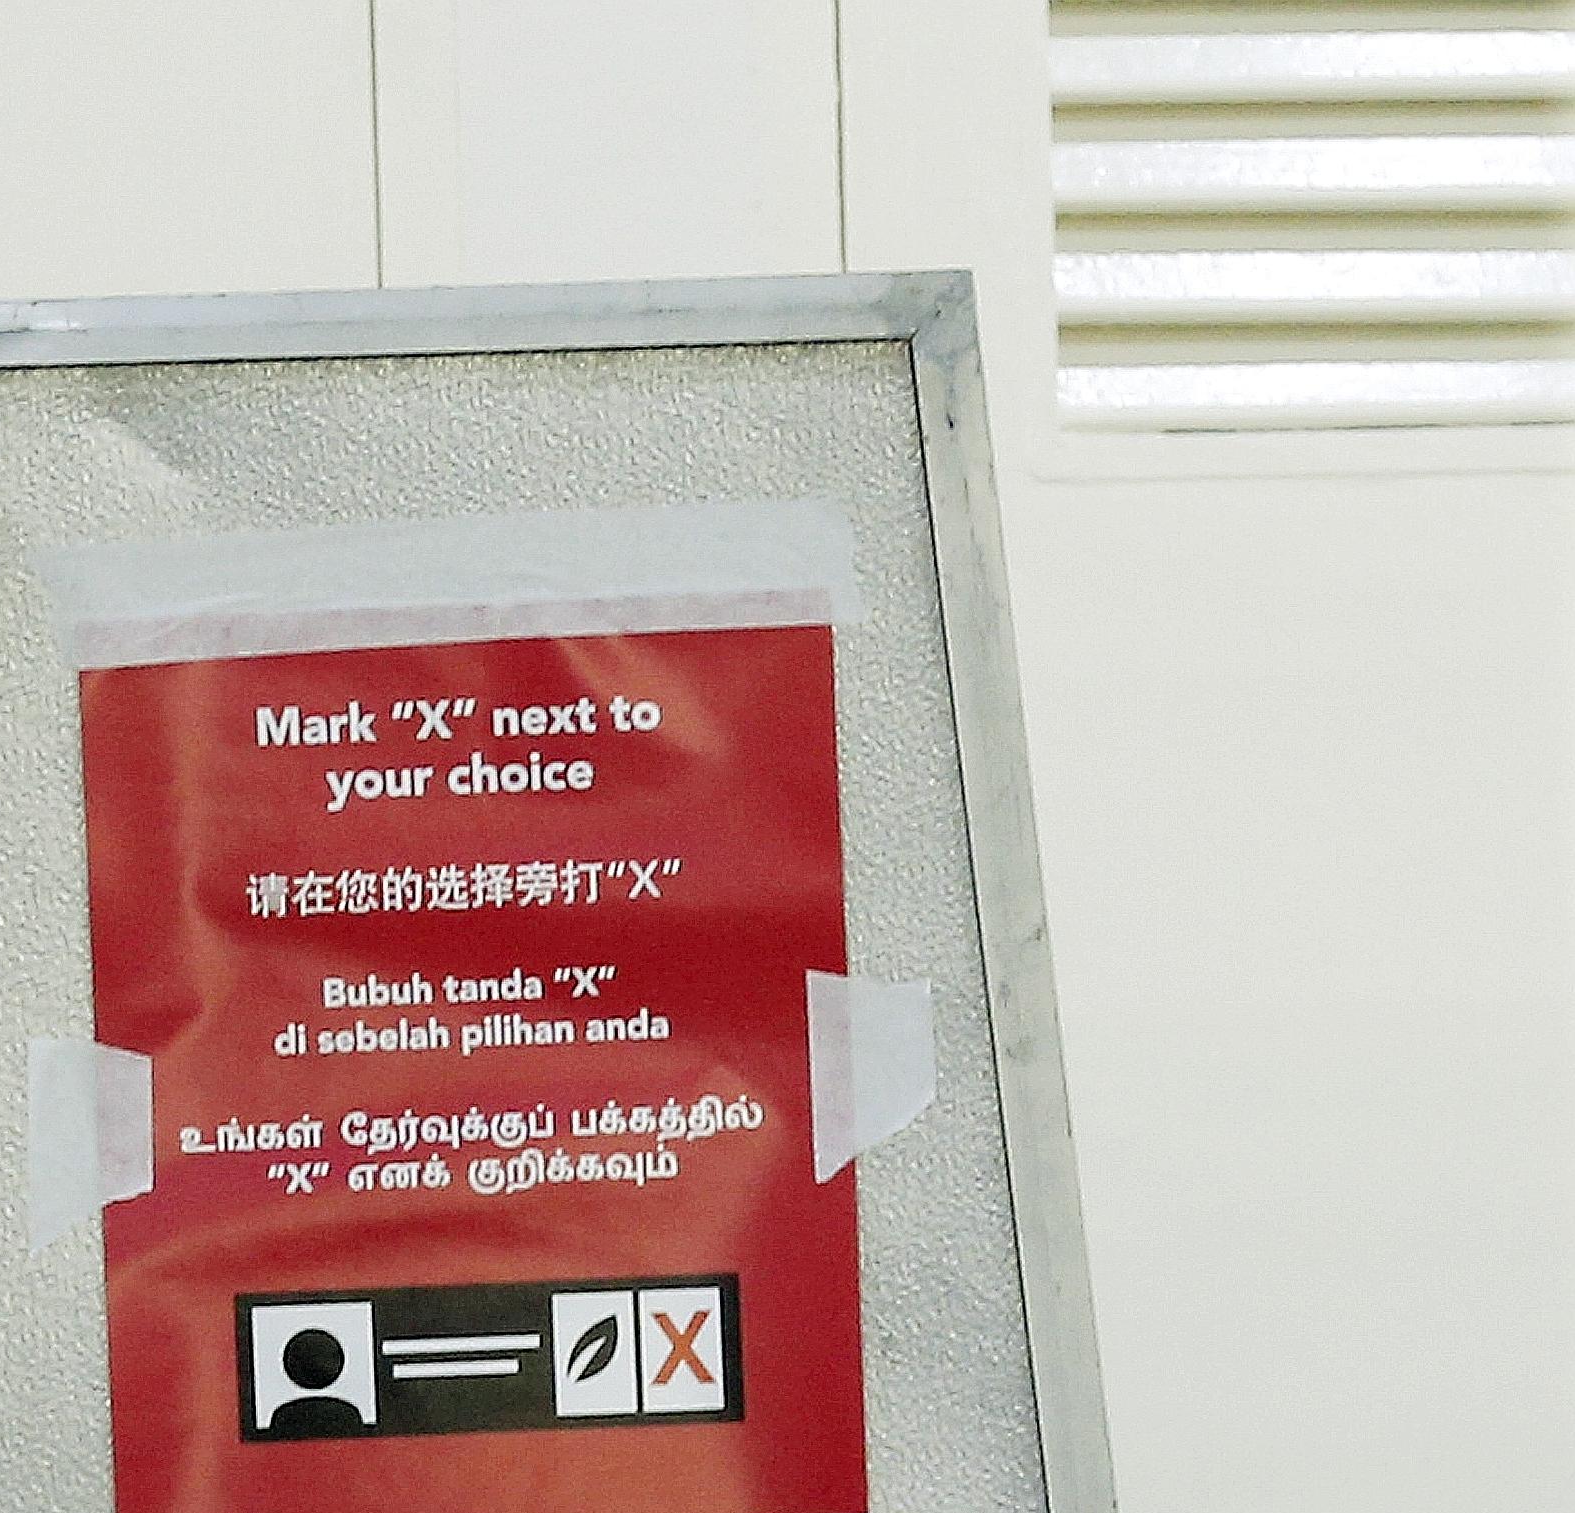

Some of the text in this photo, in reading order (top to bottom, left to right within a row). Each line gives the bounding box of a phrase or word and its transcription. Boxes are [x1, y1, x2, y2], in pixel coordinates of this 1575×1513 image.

[255, 700, 377, 748] Mark
[492, 697, 597, 737] next
[608, 694, 665, 732] to
[325, 751, 594, 813] your choice
[322, 972, 433, 1009] Bubuh
[441, 967, 543, 1004] tanda
[273, 1007, 670, 1057] di sebelah pilihan anda
[179, 1093, 764, 1155] உங்கள் தேர்வுக்குப் பக்கத்தில்
[347, 1154, 452, 1193] எனக்
[467, 1143, 679, 1195] குறிக்கவும்
